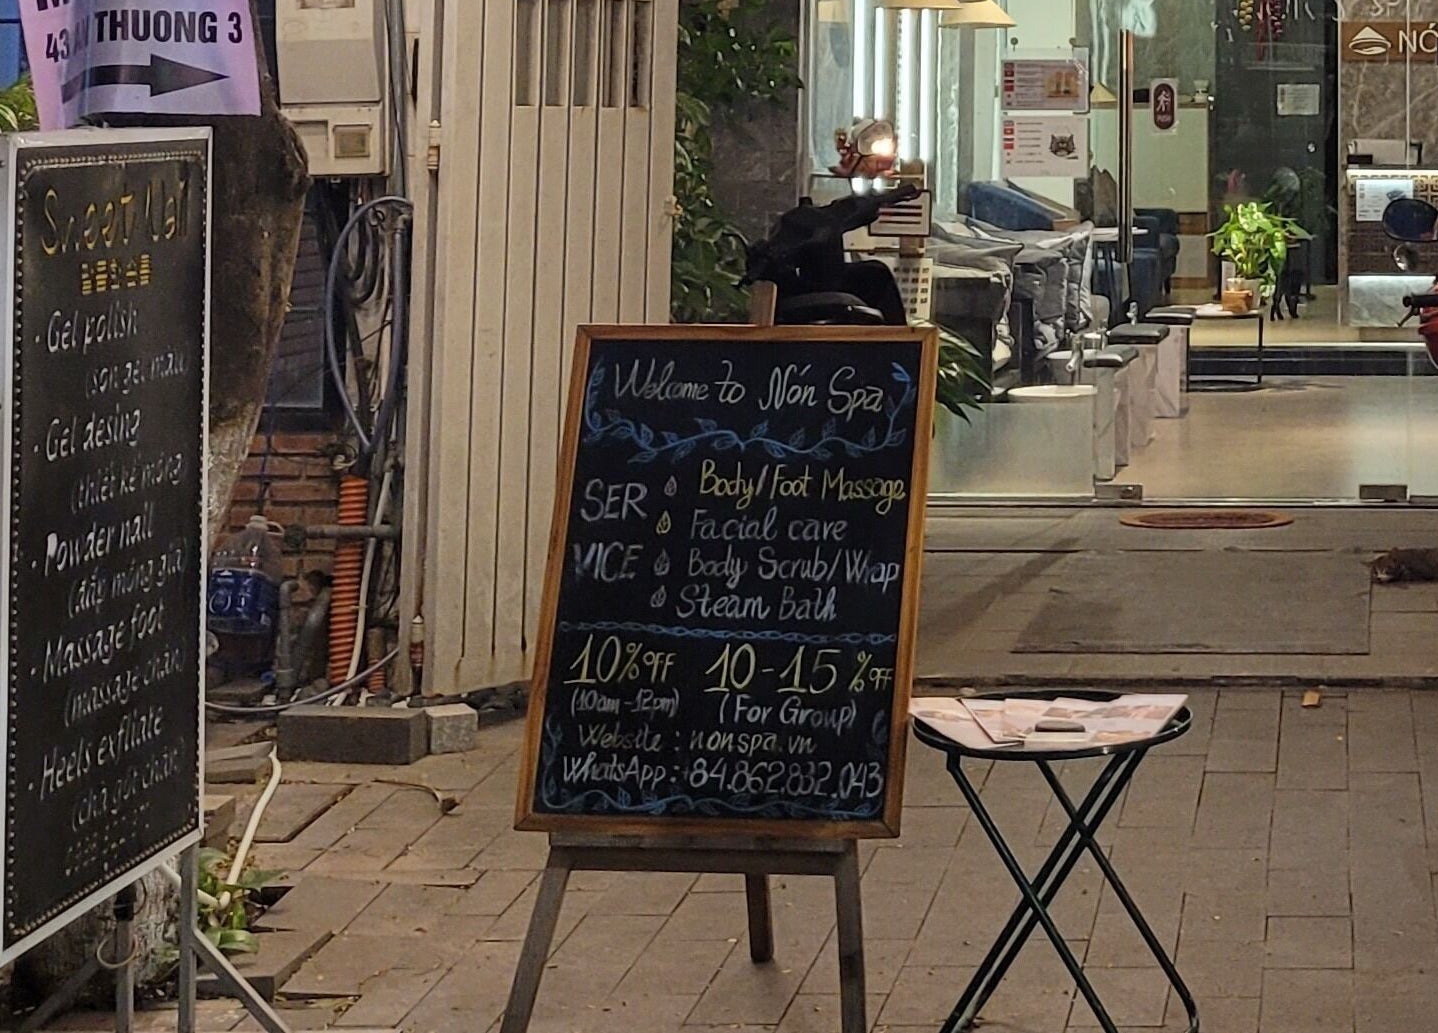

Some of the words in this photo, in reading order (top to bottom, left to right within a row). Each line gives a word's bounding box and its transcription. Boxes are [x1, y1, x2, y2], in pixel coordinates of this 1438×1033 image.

[45, 26, 71, 64] 43
[95, 10, 218, 44] THUONG
[228, 11, 243, 44] 3
[46, 309, 78, 353] Gel
[83, 300, 138, 354] polish
[614, 357, 709, 401] Welcome
[714, 359, 746, 404] to
[828, 366, 884, 423] Spa
[580, 478, 649, 523] SER
[820, 467, 907, 516] Massage
[689, 504, 778, 542] Facial
[788, 516, 849, 542] care
[688, 546, 749, 590] Body
[676, 583, 772, 621] Steam
[777, 584, 839, 621] Bath
[42, 620, 125, 682] Massage
[39, 738, 92, 800] Heels
